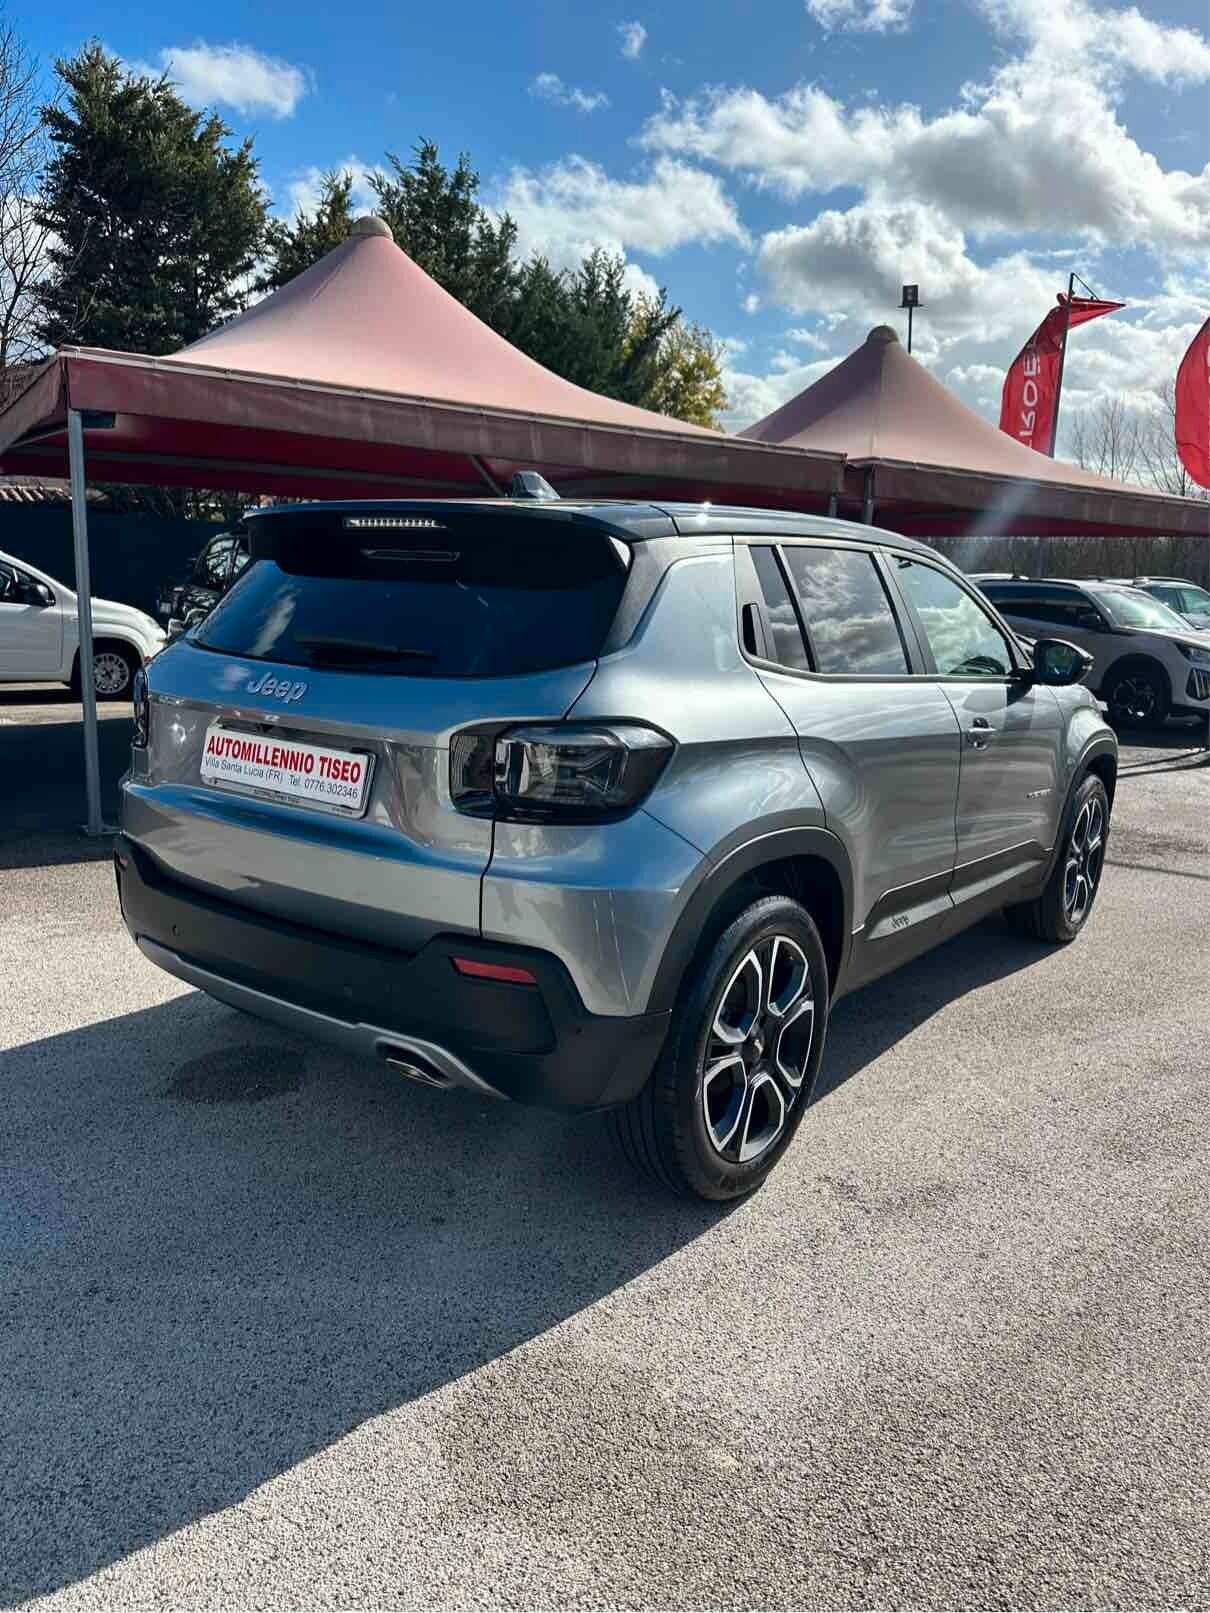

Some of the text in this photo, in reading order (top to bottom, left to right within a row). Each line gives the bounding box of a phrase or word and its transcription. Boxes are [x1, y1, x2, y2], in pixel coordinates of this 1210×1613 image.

[247, 672, 307, 703] Jeep
[205, 757, 219, 769] Villa
[221, 760, 242, 774] Santa
[244, 763, 264, 778] Lucia
[265, 767, 283, 783] (FR)
[304, 778, 358, 799] 0776.302346
[207, 735, 361, 783] AUTOMILLENNIO TISEO
